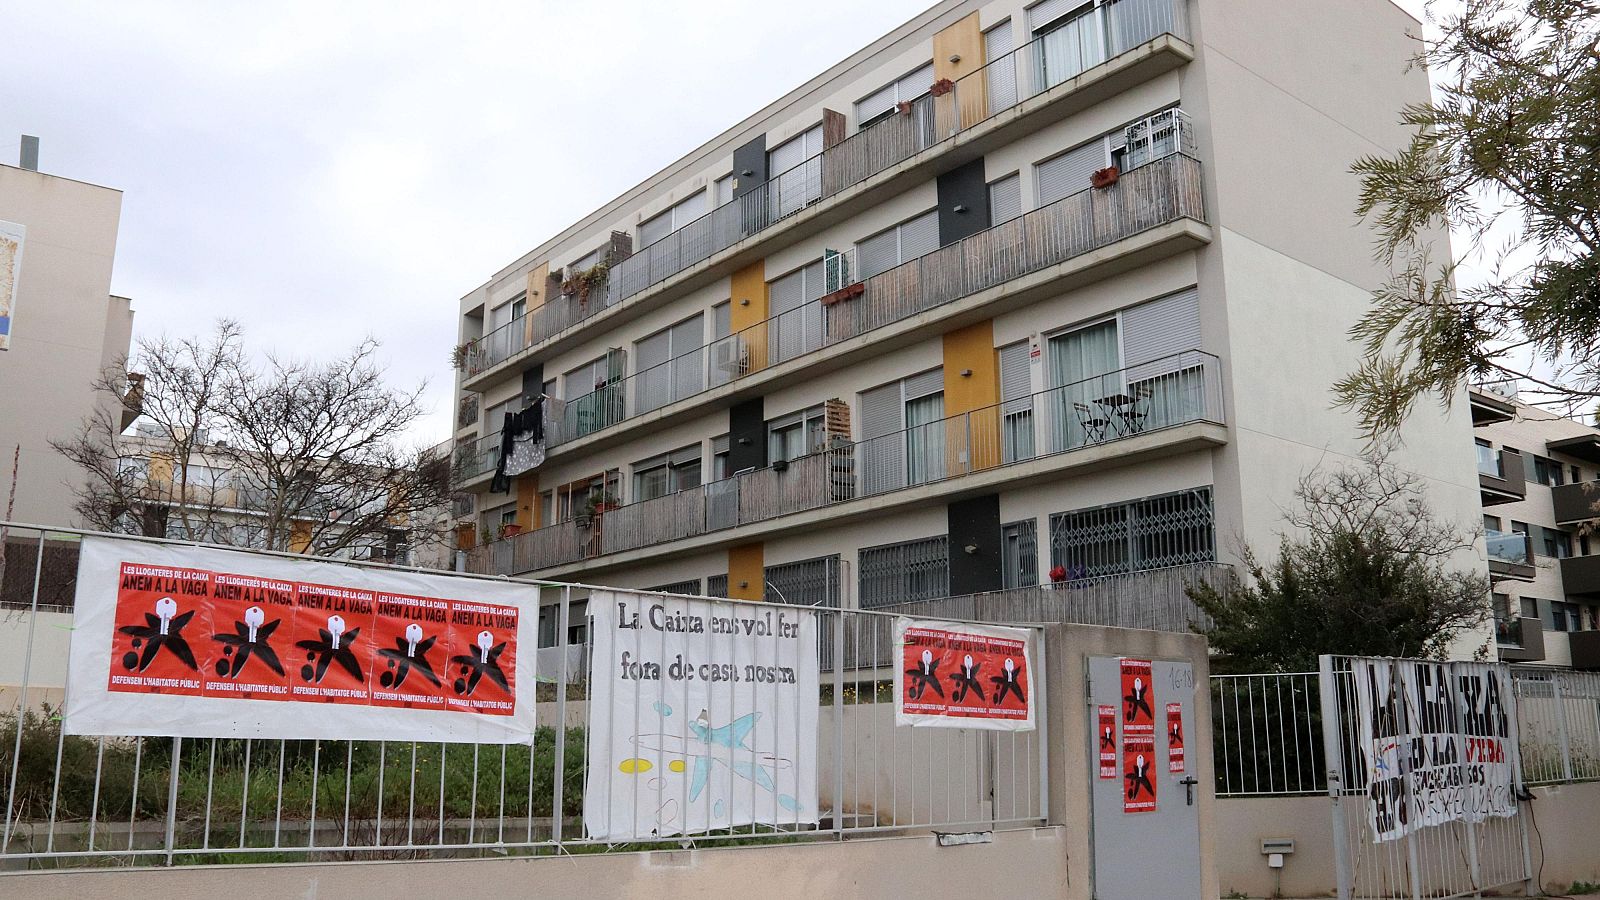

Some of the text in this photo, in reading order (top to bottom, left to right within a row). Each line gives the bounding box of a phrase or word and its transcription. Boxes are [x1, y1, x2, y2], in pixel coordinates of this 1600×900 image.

[123, 565, 209, 581] LES LLOGATERES DE LA CAIXA
[122, 576, 208, 596] ANEM A LA VAGA
[215, 575, 293, 592] LES LLOGATERES DE LA CAIXA
[298, 585, 373, 601] LES LLOGATERES DE LA CAIXA
[214, 584, 292, 606] ANEM A LA VAGA
[298, 593, 372, 615] ANEM A LA VAGA
[389, 596, 419, 606] LLOGATERES
[434, 601, 448, 609] CAIXA
[378, 603, 447, 623] ANEM A LA VAGA
[452, 610, 515, 629] ANEM A LA VAGA
[618, 603, 799, 638] La Caixa ens vol fer
[621, 651, 796, 684] fora de casa nostra
[112, 675, 200, 688] DEFENSEM L'HABITATGE PÚBLIC
[206, 681, 287, 694] DEFENSEM L'HABITATGE PÚBLIC
[293, 686, 368, 698] DEFENSEM L'HABITATGE PÚBLIC
[1415, 665, 1508, 738] CAXA
